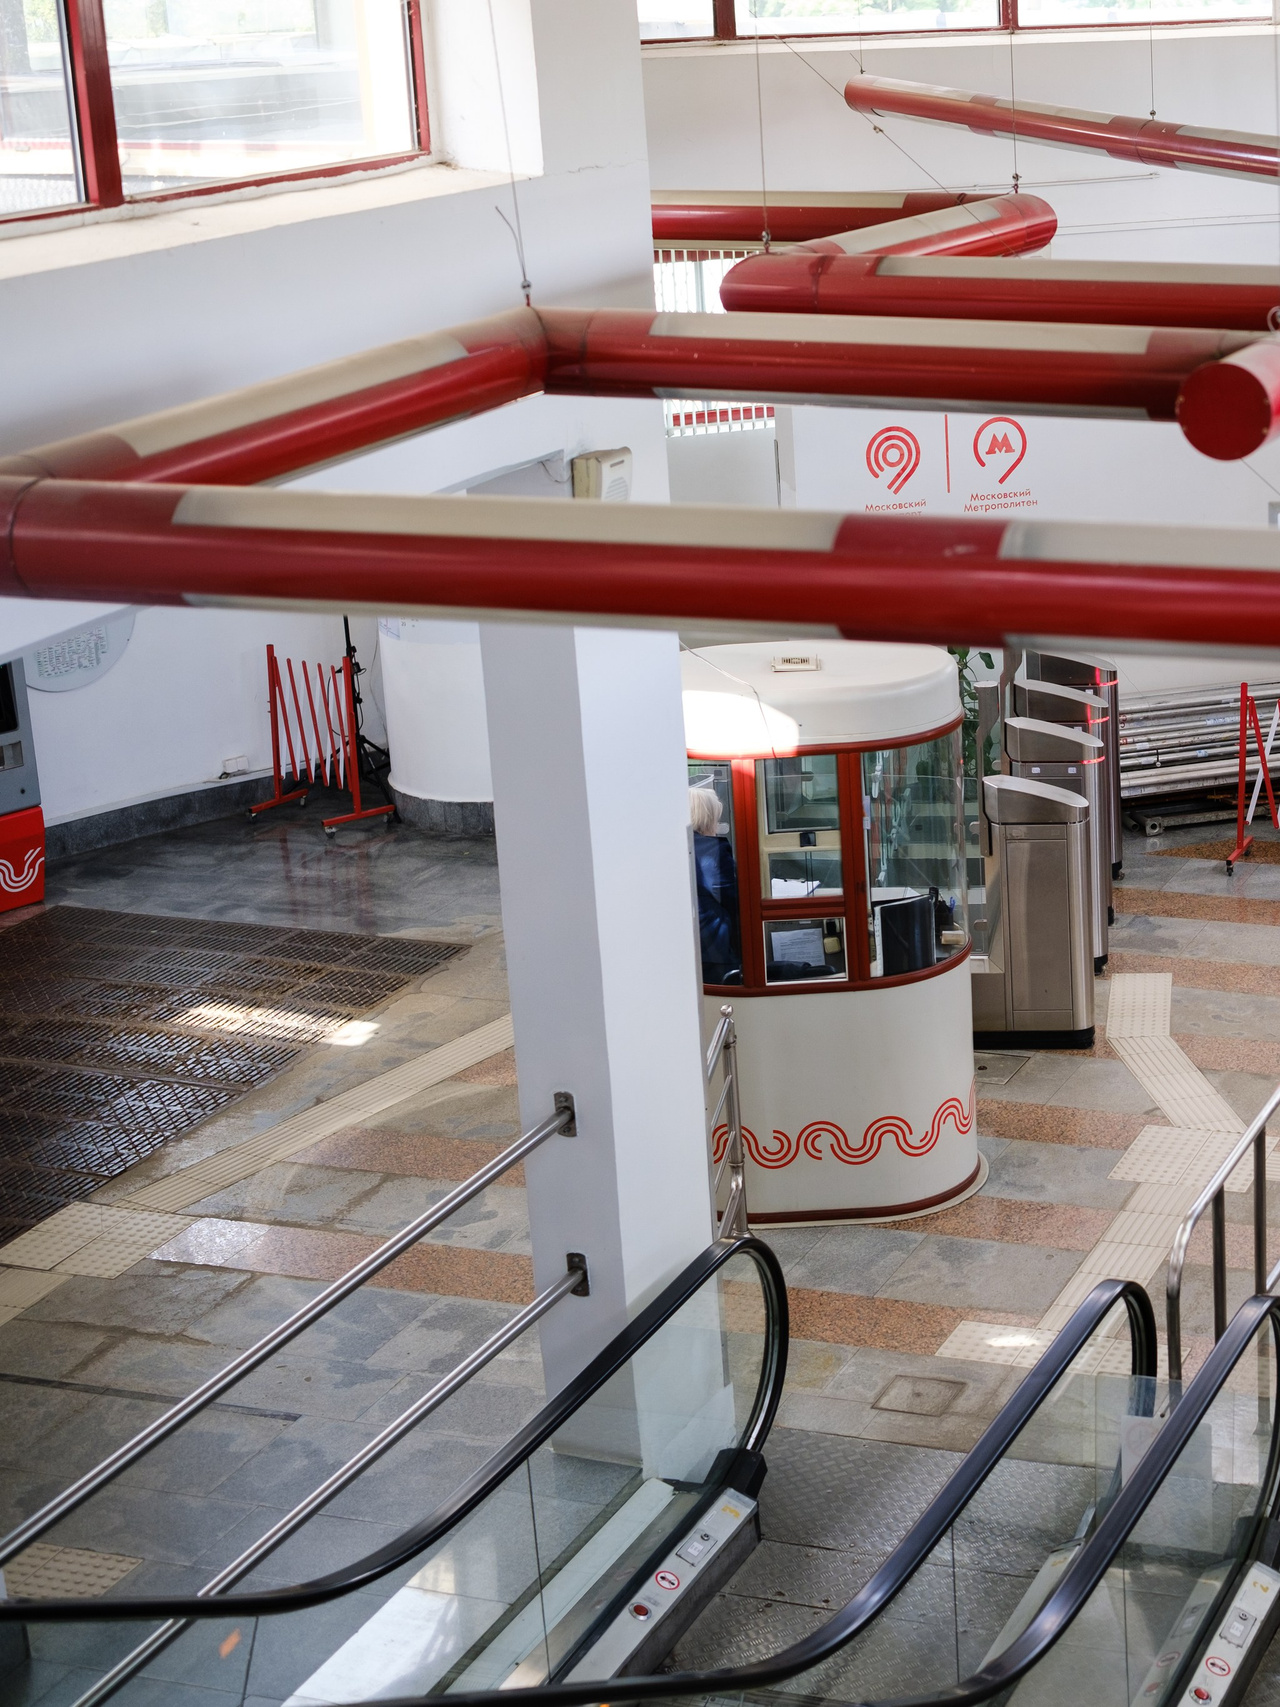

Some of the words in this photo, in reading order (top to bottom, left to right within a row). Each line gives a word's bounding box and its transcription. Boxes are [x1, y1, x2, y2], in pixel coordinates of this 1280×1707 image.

[970, 488, 1031, 502] Московский
[865, 499, 927, 512] Московский
[963, 499, 1038, 513] Метрополитен
